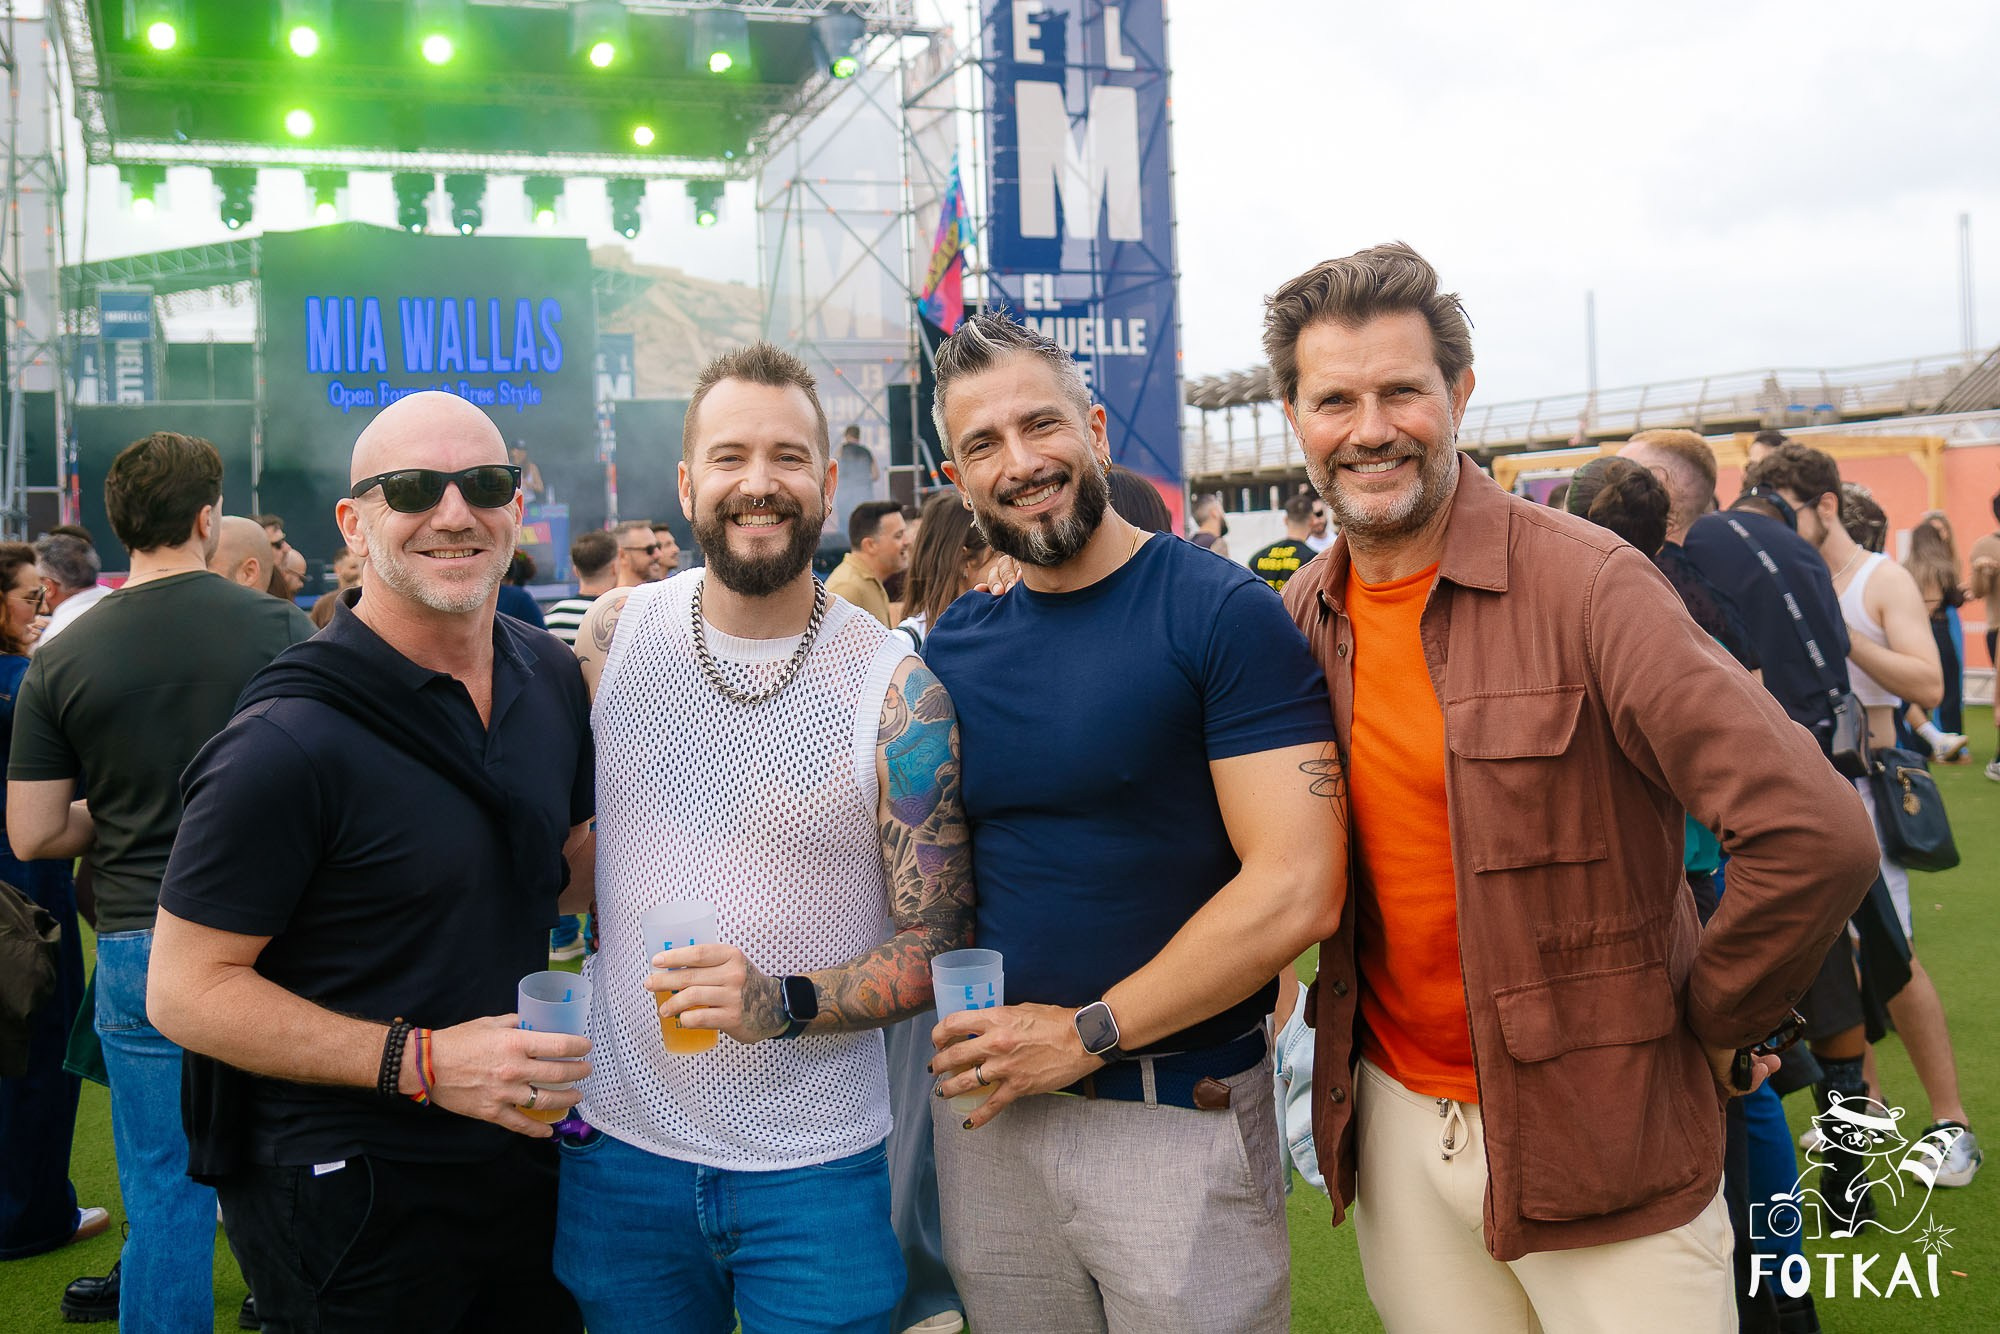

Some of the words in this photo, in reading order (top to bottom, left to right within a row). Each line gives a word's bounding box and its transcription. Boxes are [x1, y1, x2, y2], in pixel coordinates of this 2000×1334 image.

[1015, 80, 1142, 241] M
[1024, 273, 1062, 311] EL
[306, 297, 387, 373] MIA
[399, 298, 562, 373] WALLAS
[330, 382, 374, 412] Open
[459, 380, 495, 404] Free
[498, 382, 542, 412] Style
